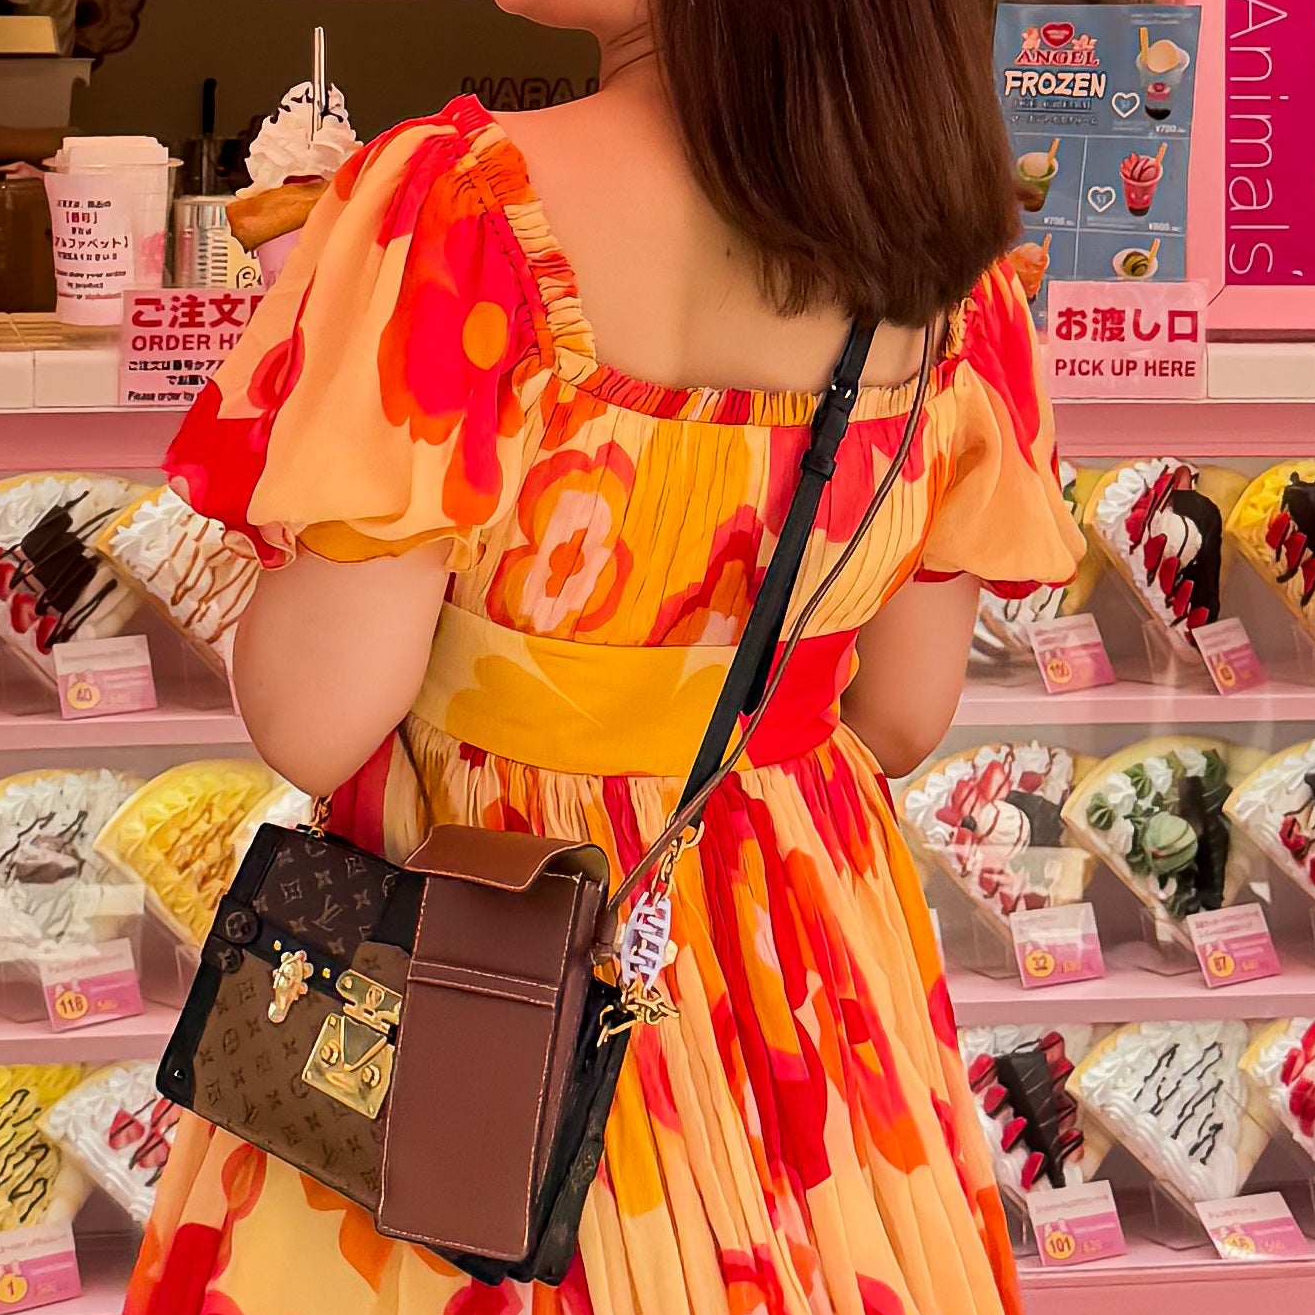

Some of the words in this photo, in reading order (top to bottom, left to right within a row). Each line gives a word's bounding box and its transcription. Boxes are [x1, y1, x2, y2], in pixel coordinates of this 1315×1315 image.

[1013, 49, 1100, 68] ANGEL
[1004, 70, 1107, 99] FROZEN
[1055, 306, 1199, 344] お渡し口
[131, 334, 211, 351] ORDER
[1055, 358, 1103, 377] PICK
[1111, 359, 1138, 377] UP
[1144, 359, 1196, 378] HERE
[1048, 1239, 1072, 1255] 101
